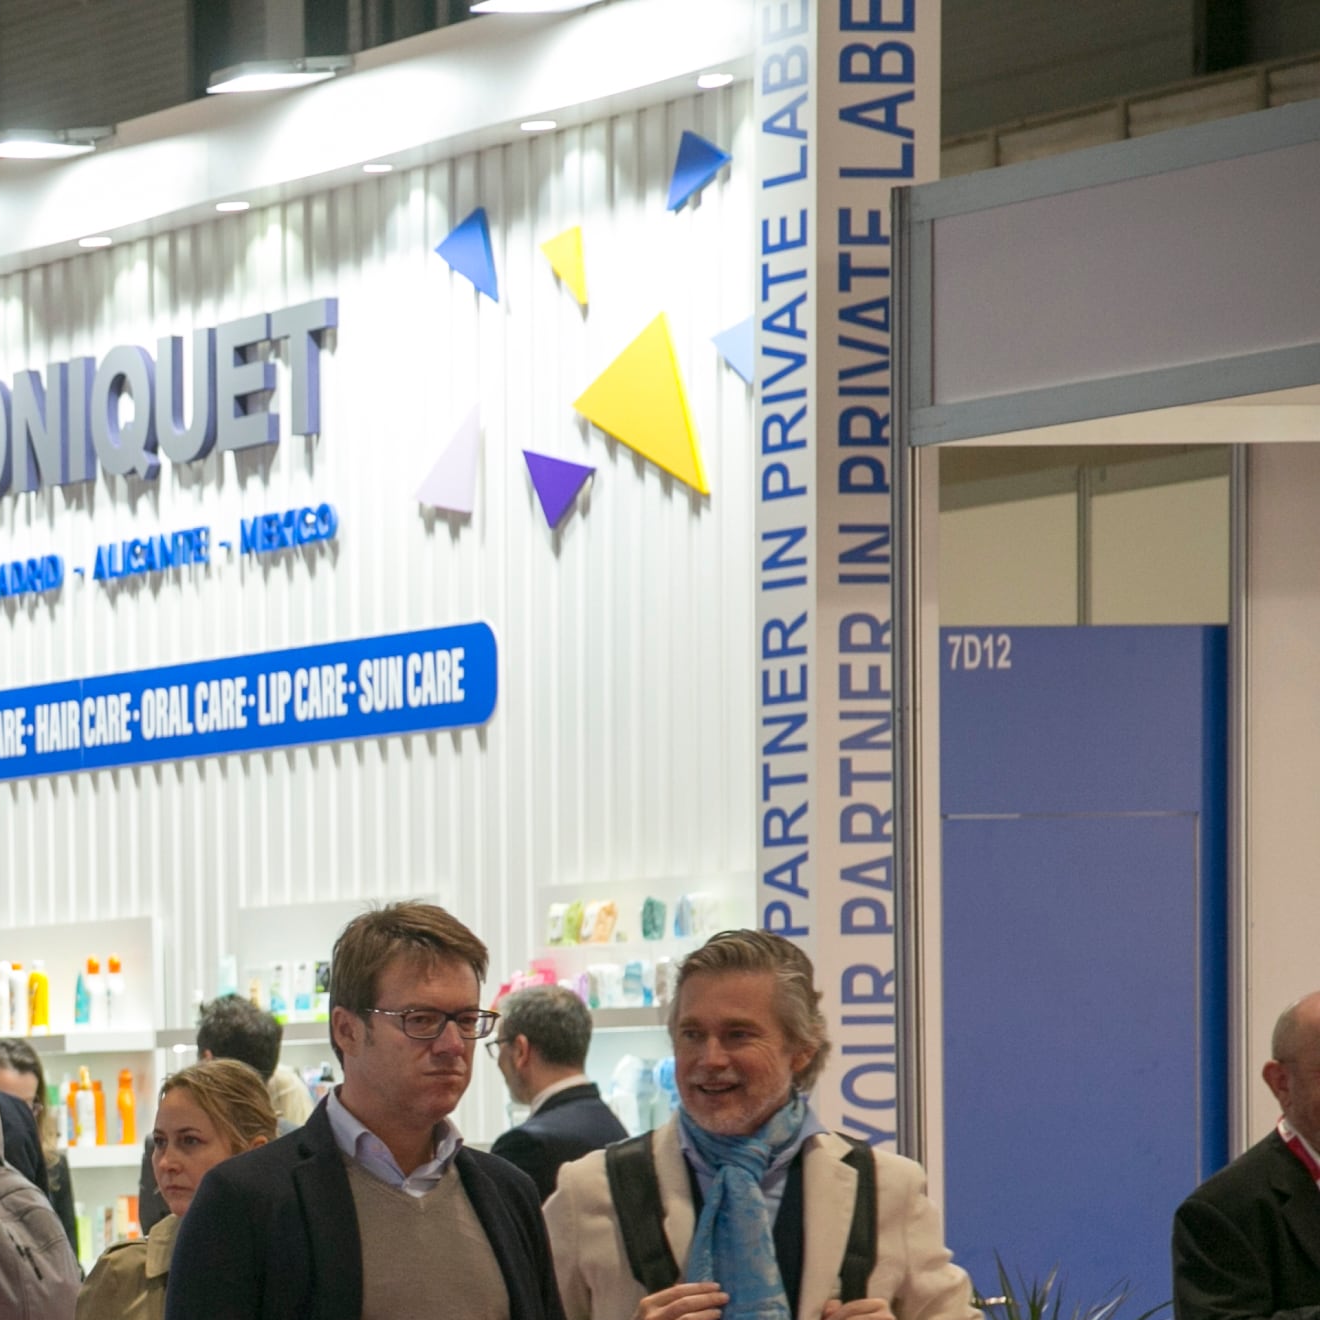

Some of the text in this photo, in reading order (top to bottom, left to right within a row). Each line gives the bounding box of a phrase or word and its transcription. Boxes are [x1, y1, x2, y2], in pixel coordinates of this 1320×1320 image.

[762, 208, 808, 503] PRIVATE
[92, 526, 210, 581] ALICANTE
[239, 502, 339, 555] MEXICO
[762, 525, 808, 591] IN
[947, 634, 1012, 671] 7D12
[34, 700, 81, 754] HAIR
[82, 692, 132, 748] CARE
[141, 684, 194, 741] ORAL
[194, 676, 248, 734] CARE
[258, 671, 291, 726] LIP
[294, 663, 348, 722] CARE
[359, 655, 404, 714] SUN
[406, 647, 465, 708] CARE
[762, 611, 809, 938] PARTNER
